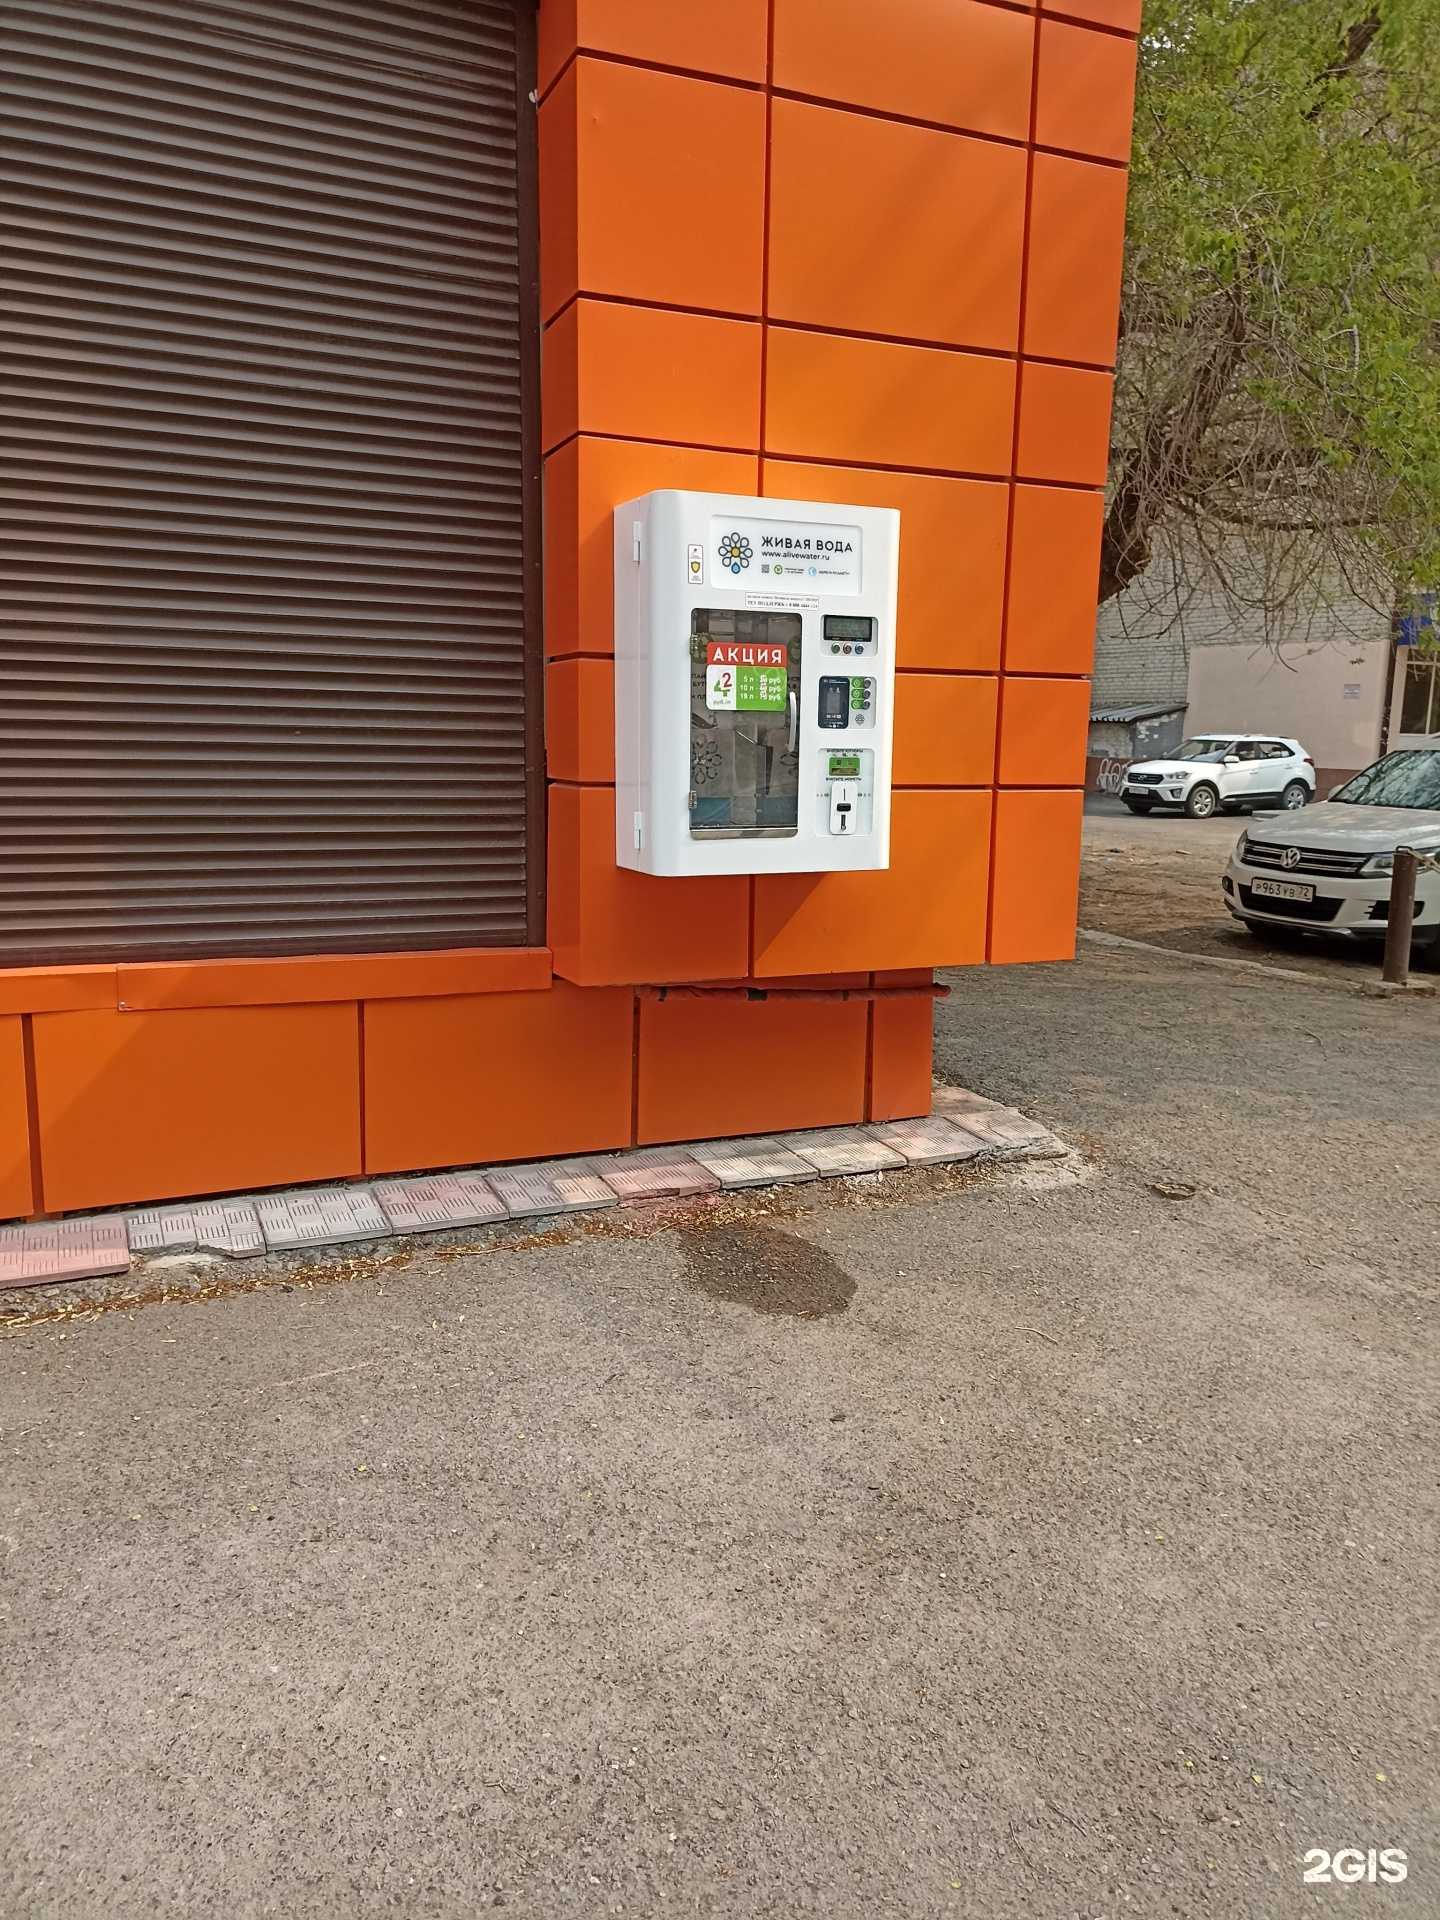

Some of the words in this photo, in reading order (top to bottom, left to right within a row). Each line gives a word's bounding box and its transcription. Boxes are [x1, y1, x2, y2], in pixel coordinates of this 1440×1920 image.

[761, 535, 811, 550] ЖИВАЯ
[816, 539, 853, 552] ВОДА
[761, 551, 830, 560] www.alivewater.ru
[712, 647, 782, 665] АКЦИЯ
[722, 672, 733, 688] 2
[1299, 886, 1310, 897] 72
